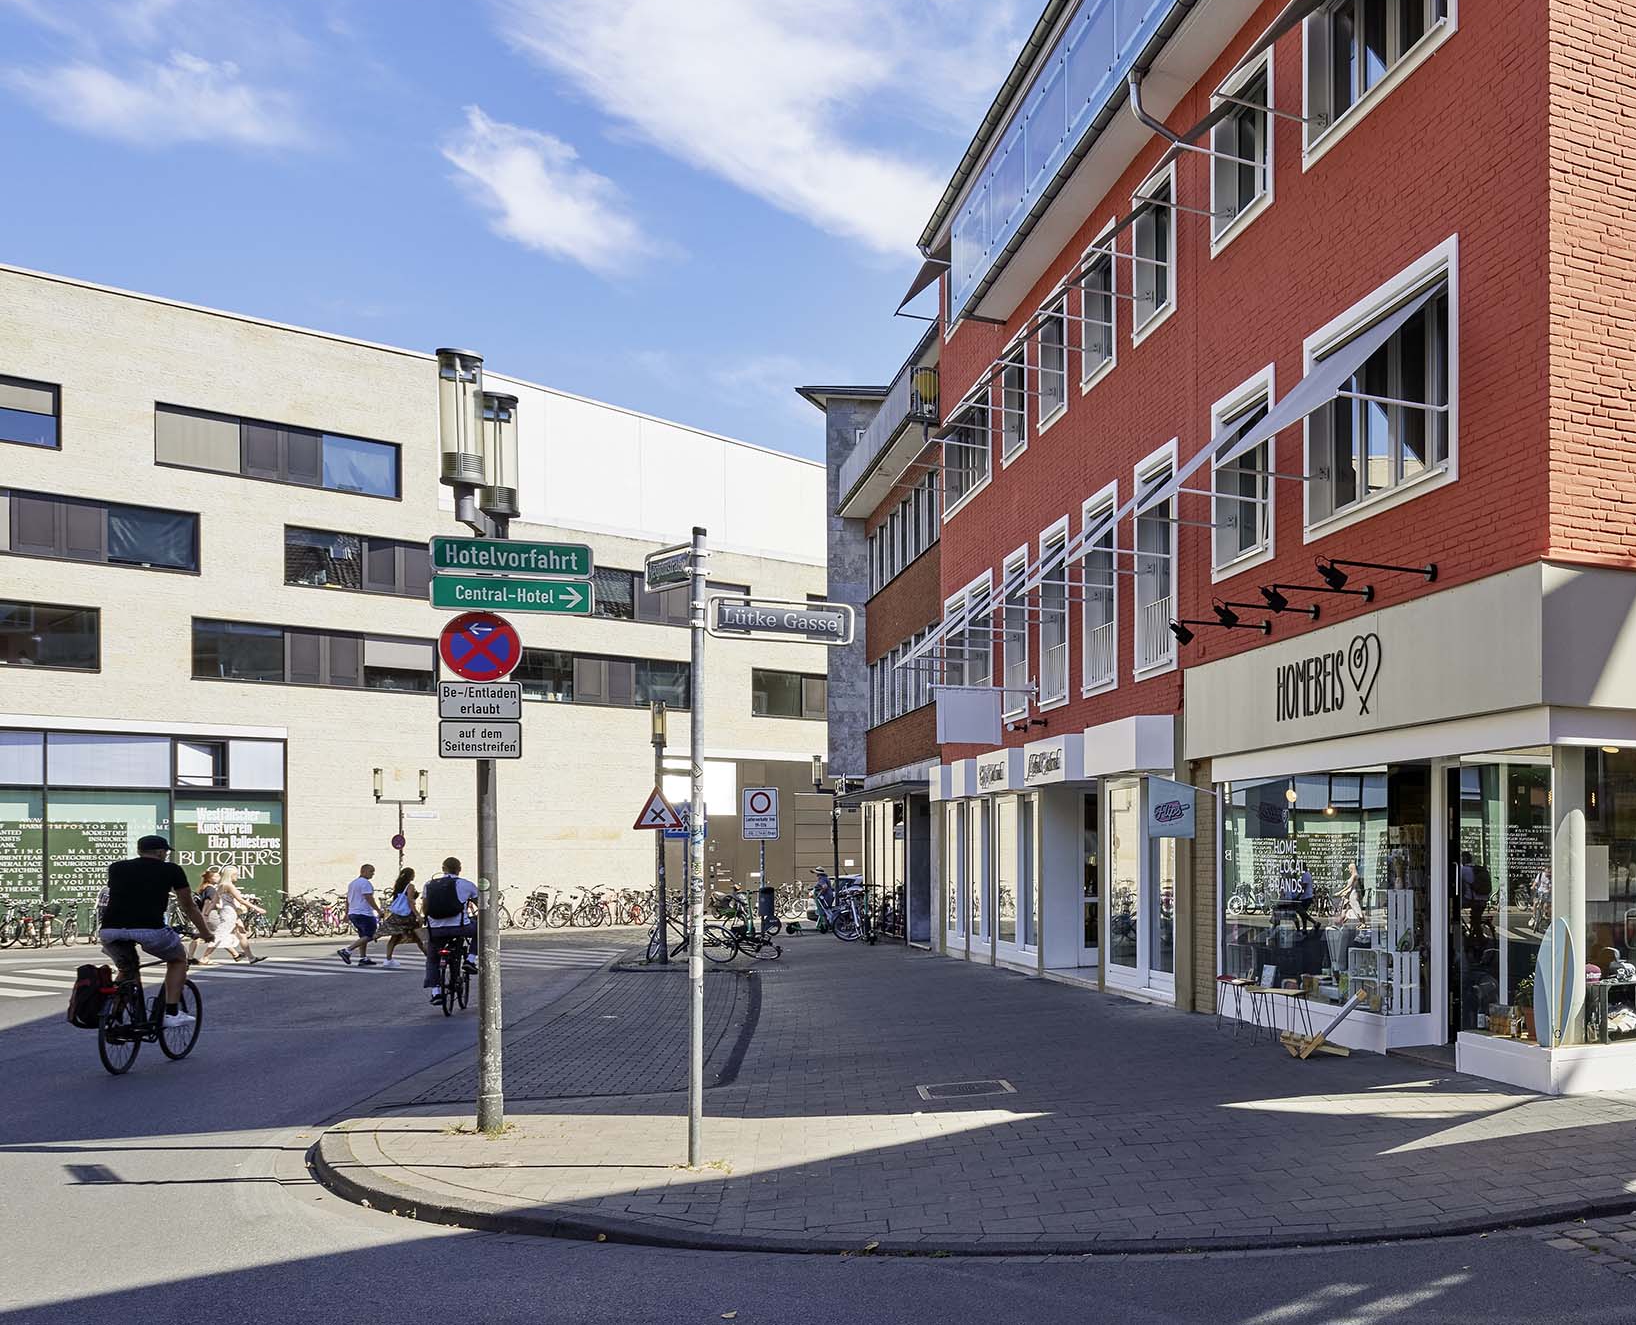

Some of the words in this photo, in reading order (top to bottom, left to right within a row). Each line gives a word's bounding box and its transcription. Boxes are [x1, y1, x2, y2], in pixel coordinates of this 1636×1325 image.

[446, 544, 578, 571] Hotelvorfahrt
[455, 585, 554, 604] Central-Hotel
[723, 608, 776, 628] Lütke
[783, 614, 838, 634] Gasse
[443, 686, 517, 699] Be-/Entladen
[1277, 650, 1345, 722] HOMEBEIS
[460, 703, 501, 715] erlaubt
[459, 728, 476, 739] auf
[481, 728, 503, 739] dem
[445, 740, 517, 753] Seitenstreifen
[197, 821, 253, 835] Kunstverein
[208, 835, 229, 848] Eliza
[230, 835, 281, 849] Ballesteros
[1274, 840, 1298, 855] HOME
[177, 849, 282, 866] BUTCHER'S
[1280, 859, 1305, 874] LOCAL
